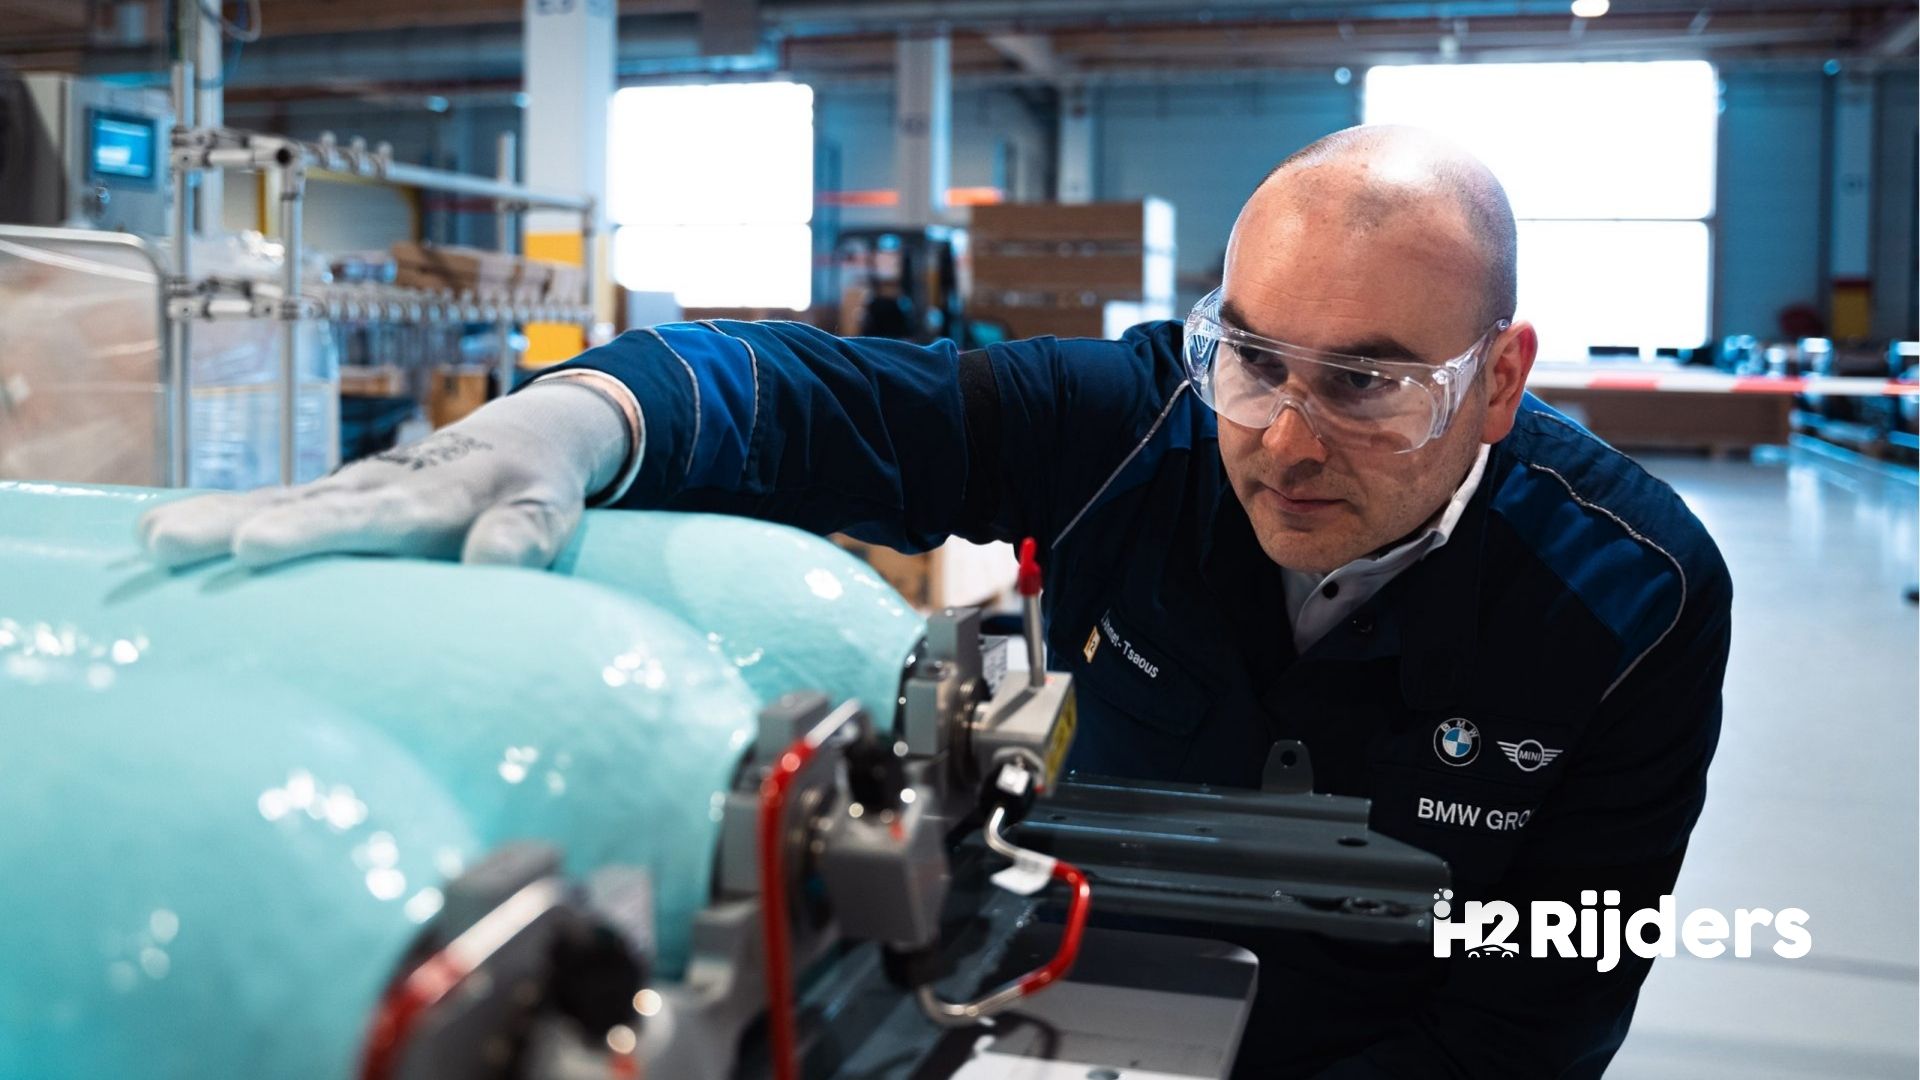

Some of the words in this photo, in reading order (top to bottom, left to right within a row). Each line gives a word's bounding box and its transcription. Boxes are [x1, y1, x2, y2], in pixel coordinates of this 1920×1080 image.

[1440, 720, 1478, 738] BMW
[1518, 750, 1542, 761] MINI
[1418, 797, 1481, 827] BMW
[1486, 809, 1535, 830] GRO
